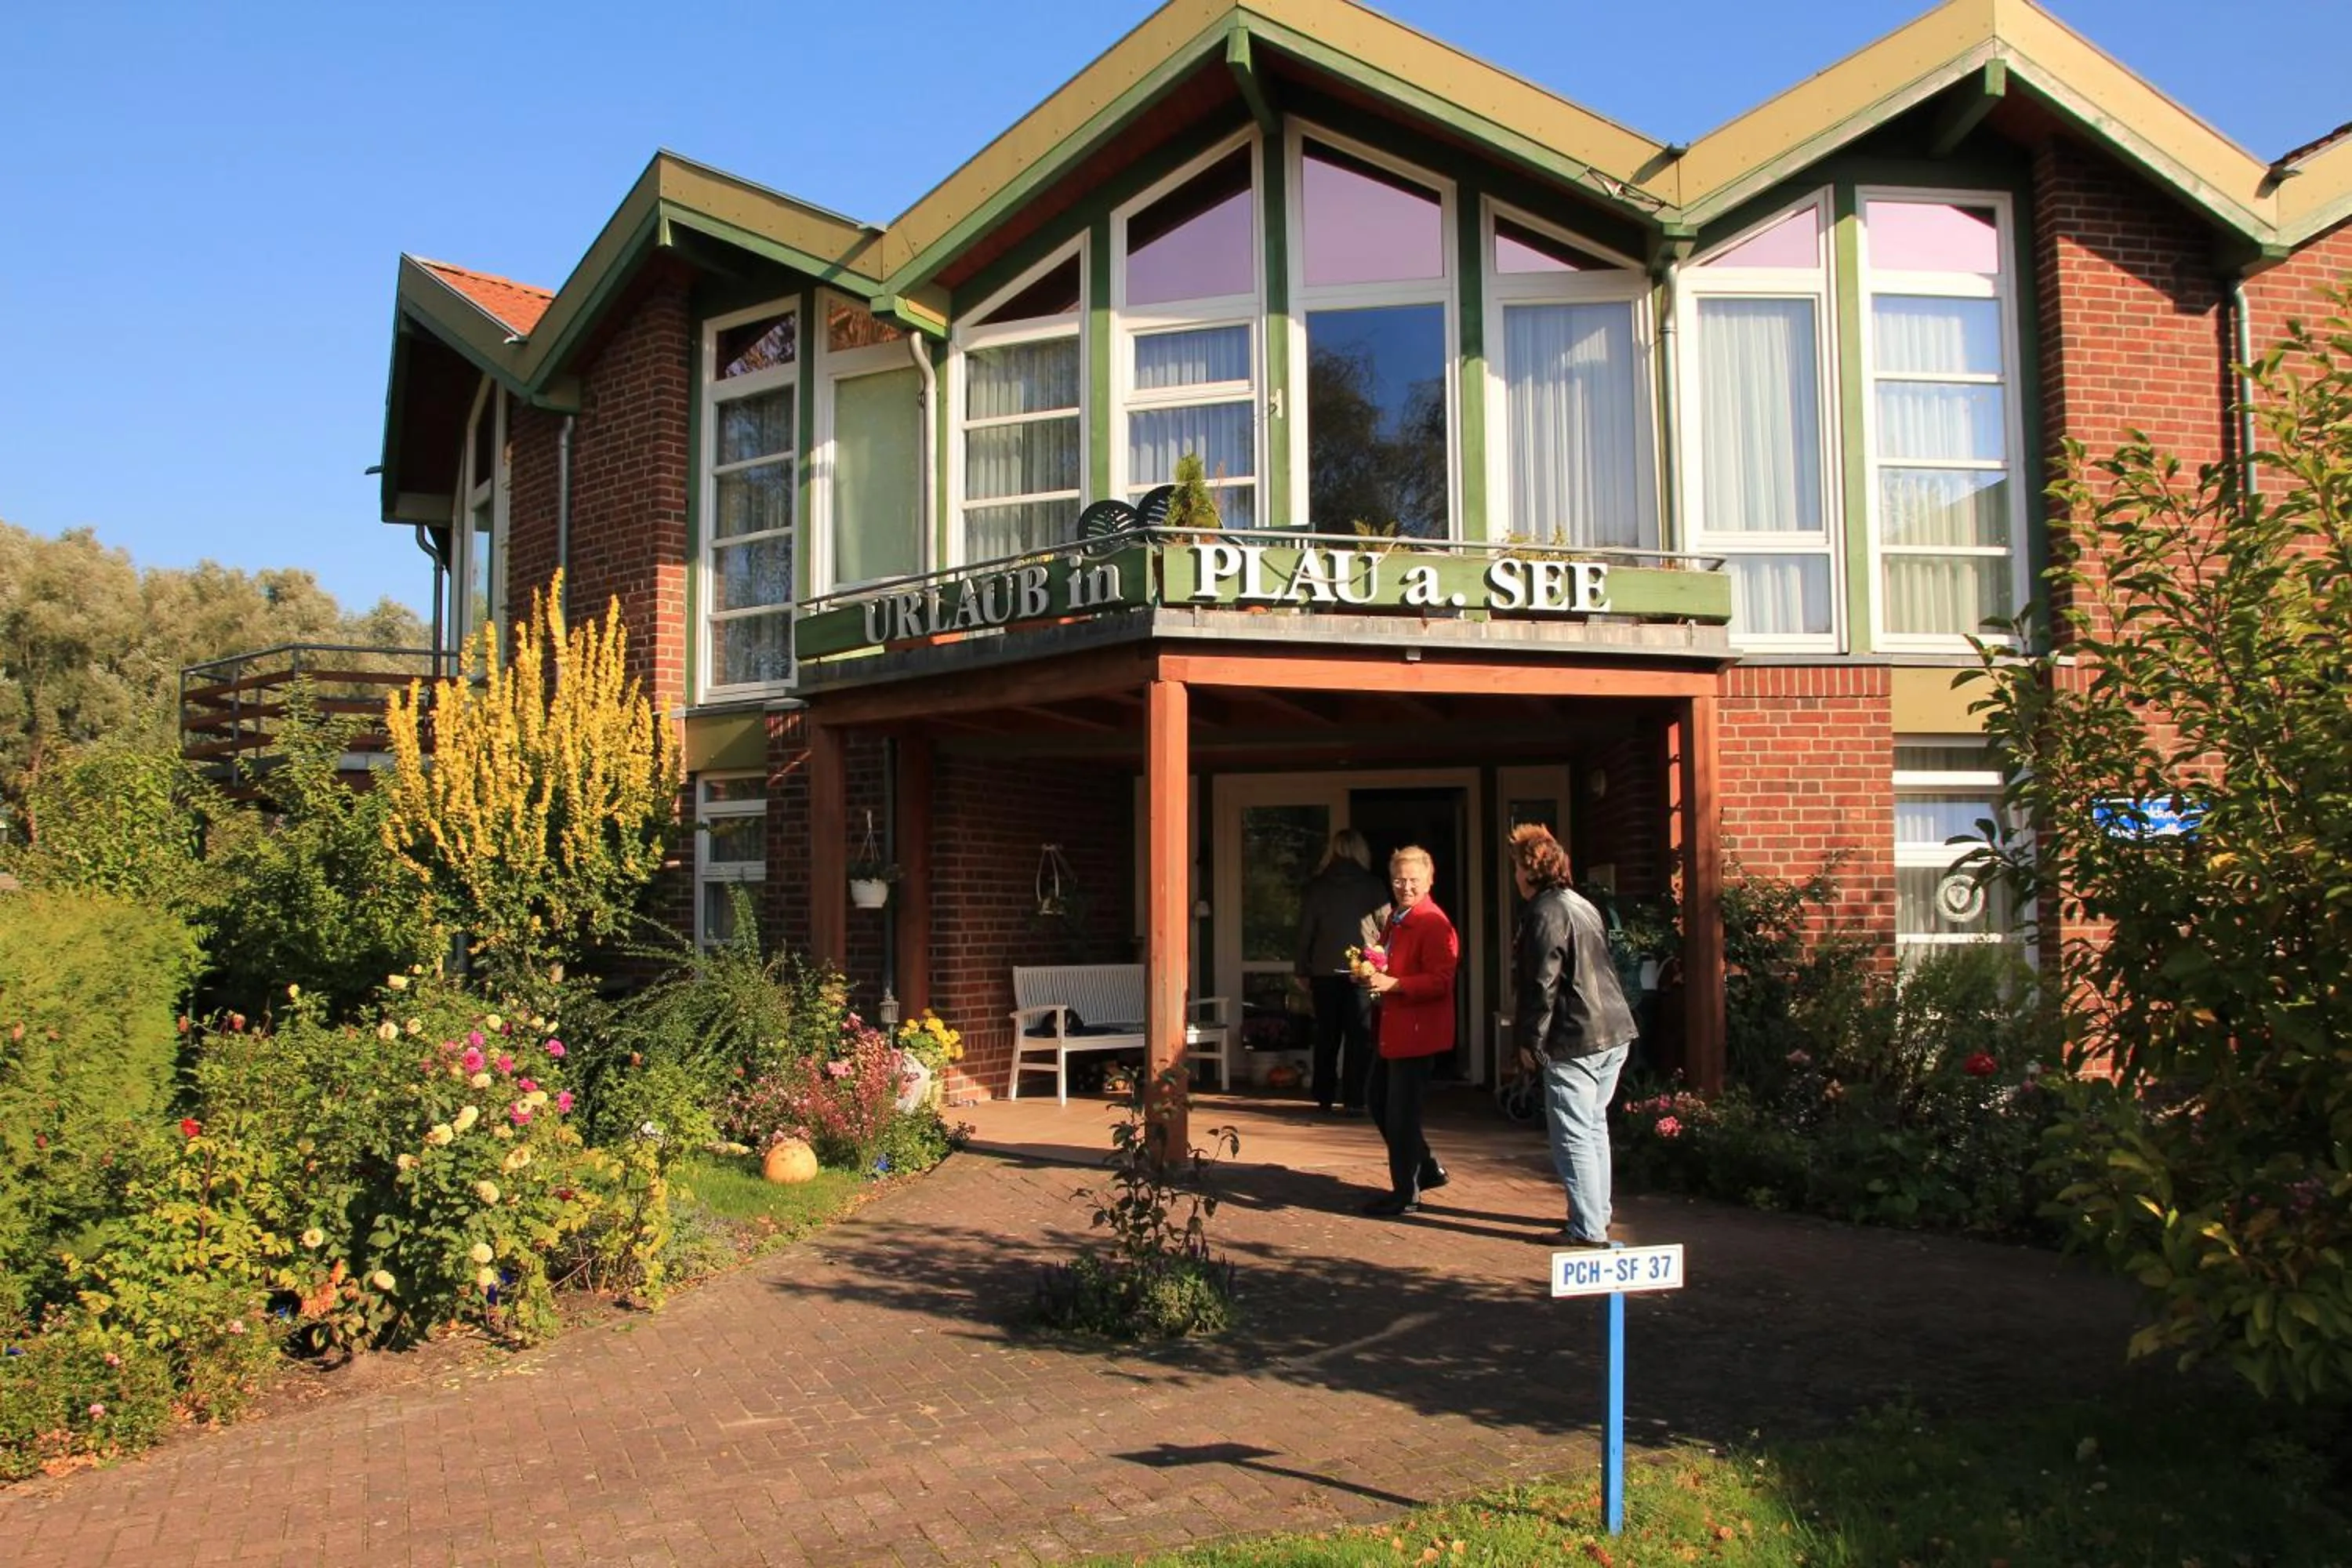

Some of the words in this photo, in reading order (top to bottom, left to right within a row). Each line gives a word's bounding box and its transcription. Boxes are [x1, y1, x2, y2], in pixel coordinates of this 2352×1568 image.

[862, 566, 1050, 644] URLAUB
[1066, 554, 1124, 608] in
[1192, 543, 1385, 603] PLAU
[1406, 565, 1466, 607] a.
[1490, 557, 1612, 612] SEE
[1563, 1258, 1639, 1285] PCH-SF
[1648, 1255, 1671, 1279] 37
